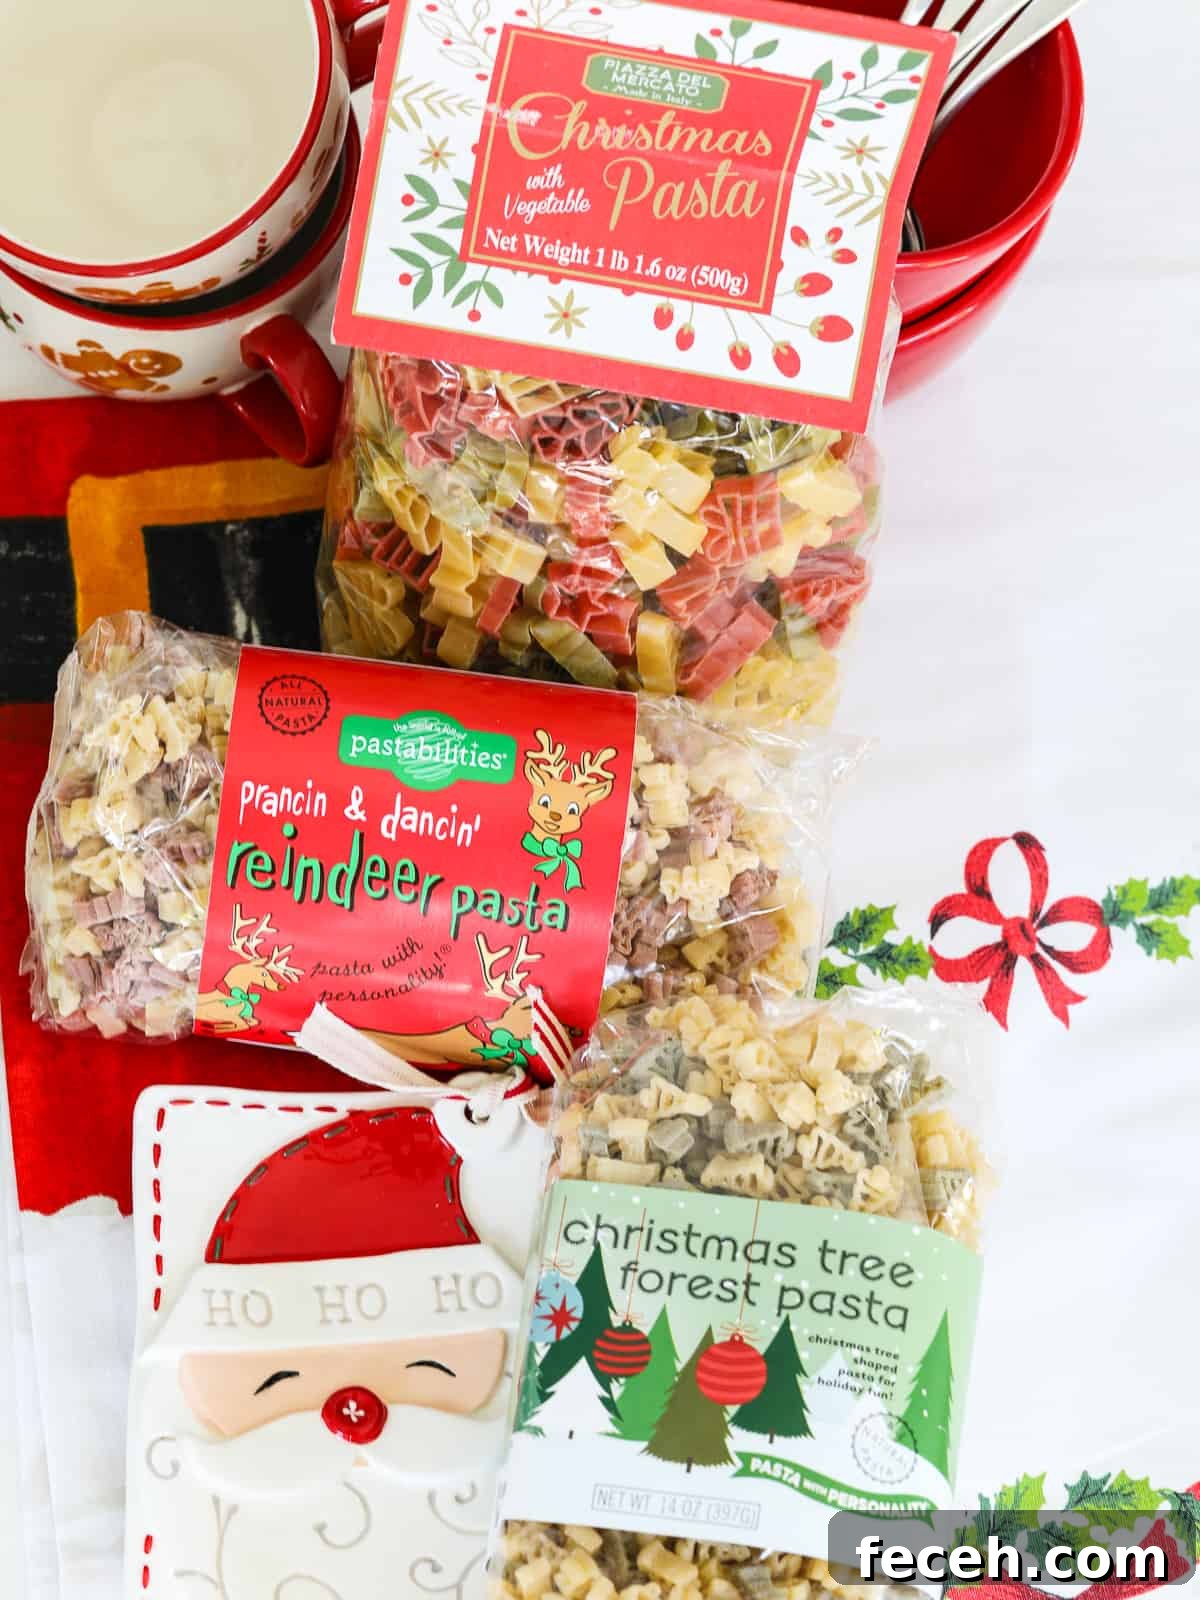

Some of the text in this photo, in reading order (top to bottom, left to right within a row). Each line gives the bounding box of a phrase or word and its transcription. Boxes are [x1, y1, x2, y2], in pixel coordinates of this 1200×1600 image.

[604, 59, 711, 88] PIAZZA DEL
[611, 72, 699, 96] MERCATO
[507, 92, 772, 160] Christmas
[526, 164, 565, 190] with
[603, 156, 765, 231] Pasta
[504, 188, 591, 224] Vegetable
[483, 227, 749, 296] Net Weight 1 lb 1.6 oz (500g)
[265, 697, 322, 706] NATURAL
[281, 680, 303, 689] ALL
[275, 713, 316, 728] PASTA
[350, 733, 502, 770] pastabilities
[239, 780, 480, 847] prancin & dancin'
[225, 823, 569, 941] reindeer pasta
[310, 936, 423, 978] pasta with
[562, 1214, 915, 1289] christmas tree
[202, 1271, 503, 1327] HO HO HO
[620, 1261, 909, 1332] forest pasta
[808, 1334, 900, 1360] christmas tree
[853, 1356, 898, 1374] shaped
[817, 1376, 893, 1400] holiday fun!
[838, 1368, 896, 1387] pasta for
[750, 1457, 801, 1488] PASTA
[827, 1488, 930, 1519] PERSONALITY
[597, 1489, 757, 1528] NET WT 14 OZ (397G)
